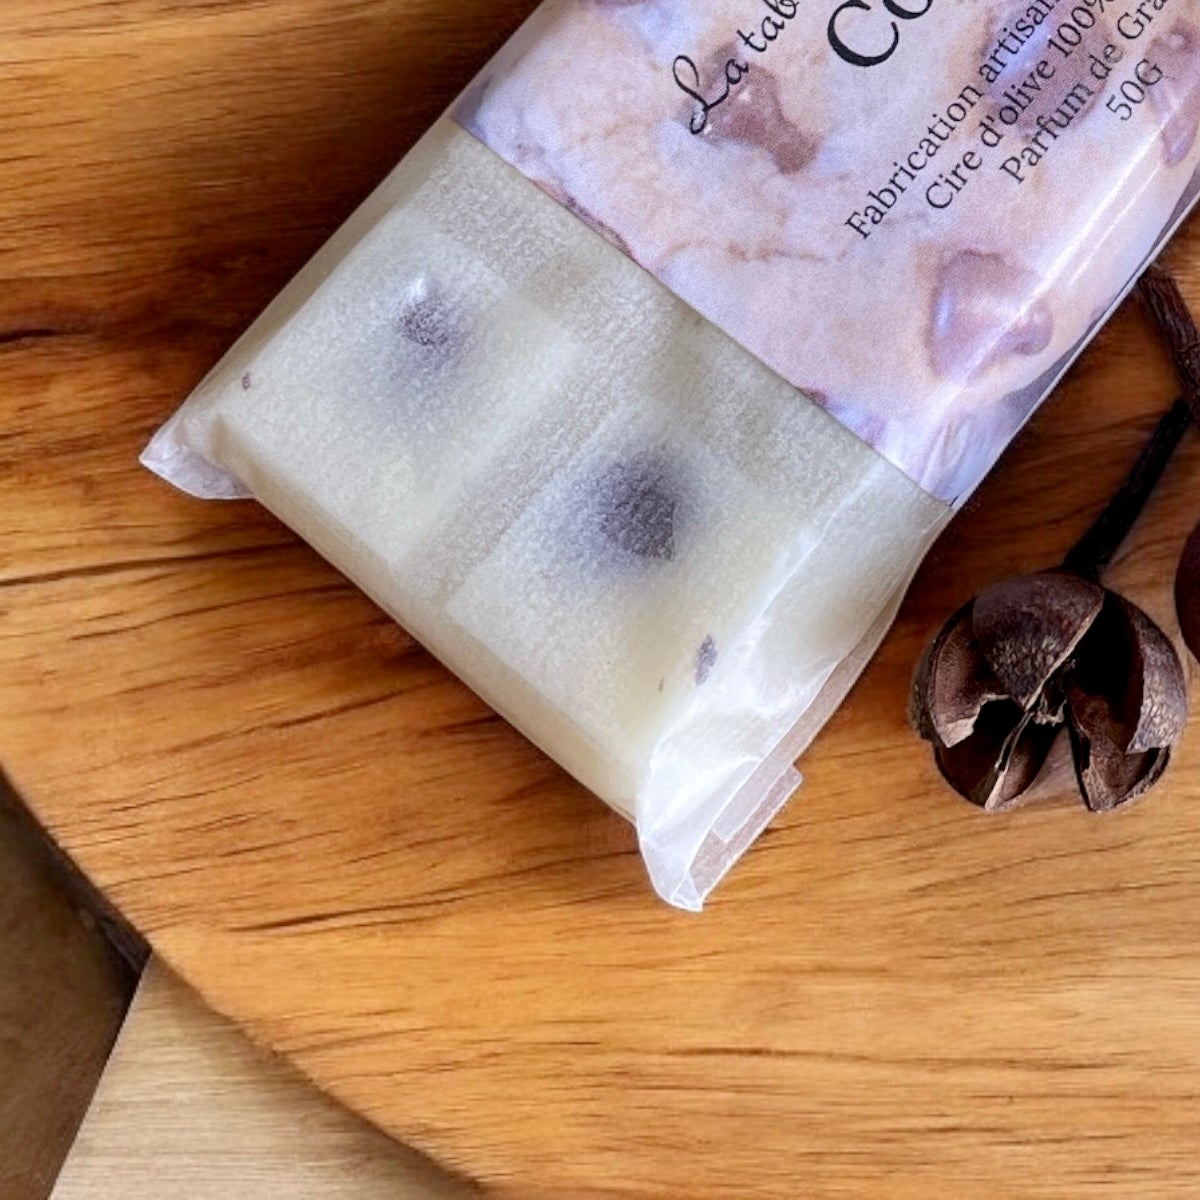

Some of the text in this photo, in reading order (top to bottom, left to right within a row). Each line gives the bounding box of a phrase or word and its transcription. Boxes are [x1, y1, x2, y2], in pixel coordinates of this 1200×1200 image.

[672, 54, 749, 135] La
[924, 150, 984, 210] Cire
[978, 58, 1057, 149] d'olive
[999, 82, 1095, 185] Parfum
[1089, 43, 1124, 82] de
[1105, 57, 1164, 121] 50G
[844, 84, 984, 240] Fabrication
